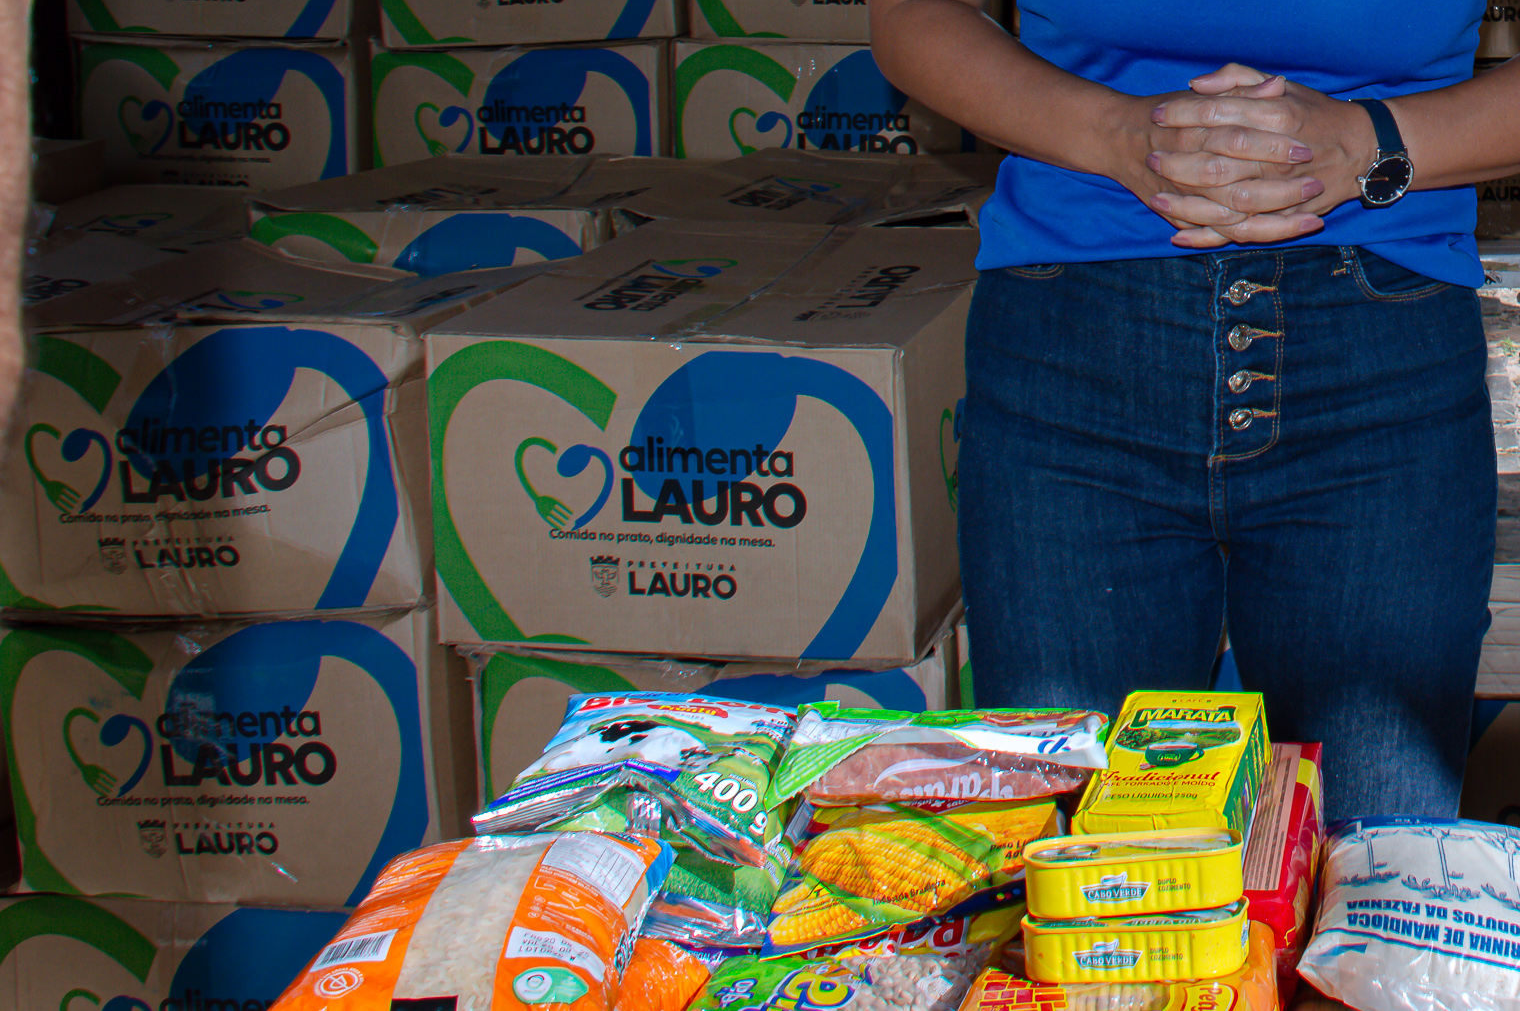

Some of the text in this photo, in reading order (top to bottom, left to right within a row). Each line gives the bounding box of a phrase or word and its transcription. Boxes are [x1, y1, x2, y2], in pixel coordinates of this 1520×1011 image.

[177, 95, 282, 119] alimenta
[476, 100, 586, 123] alimenta
[796, 105, 911, 131] alimenta
[178, 121, 291, 151] LAURO
[478, 126, 595, 155] LAURO
[836, 265, 921, 308] LAURO
[115, 419, 287, 456] alimenta
[619, 437, 793, 478] alimenta
[118, 446, 301, 504] LAURO
[59, 513, 103, 524] Comida
[214, 509, 230, 518] na
[232, 503, 271, 516] mesa.
[620, 477, 807, 529] LAURO
[549, 528, 776, 547] Comida no prato, dignidade na mesa.
[135, 545, 240, 569] LAURO
[627, 560, 736, 571] PREFEITURA
[628, 571, 737, 600] LAURO
[161, 741, 336, 786] LAURO
[1105, 770, 1221, 781] Tradicional
[97, 796, 141, 806] Comida
[160, 797, 194, 808] prato,
[197, 795, 255, 808] dignidade
[257, 797, 273, 805] na
[275, 796, 310, 805] mesa.
[693, 771, 758, 813] 400
[1174, 793, 1198, 801] 250g
[176, 831, 278, 855] LAURO
[1087, 887, 1142, 900] CABO VERDE
[1158, 883, 1191, 892] COZIMENTO
[1347, 900, 1421, 915] FAZENDA
[1425, 904, 1448, 921] DA
[1347, 912, 1440, 942] MANDIOCA
[1444, 927, 1464, 948] DE
[1080, 954, 1135, 965] CABO VERDE
